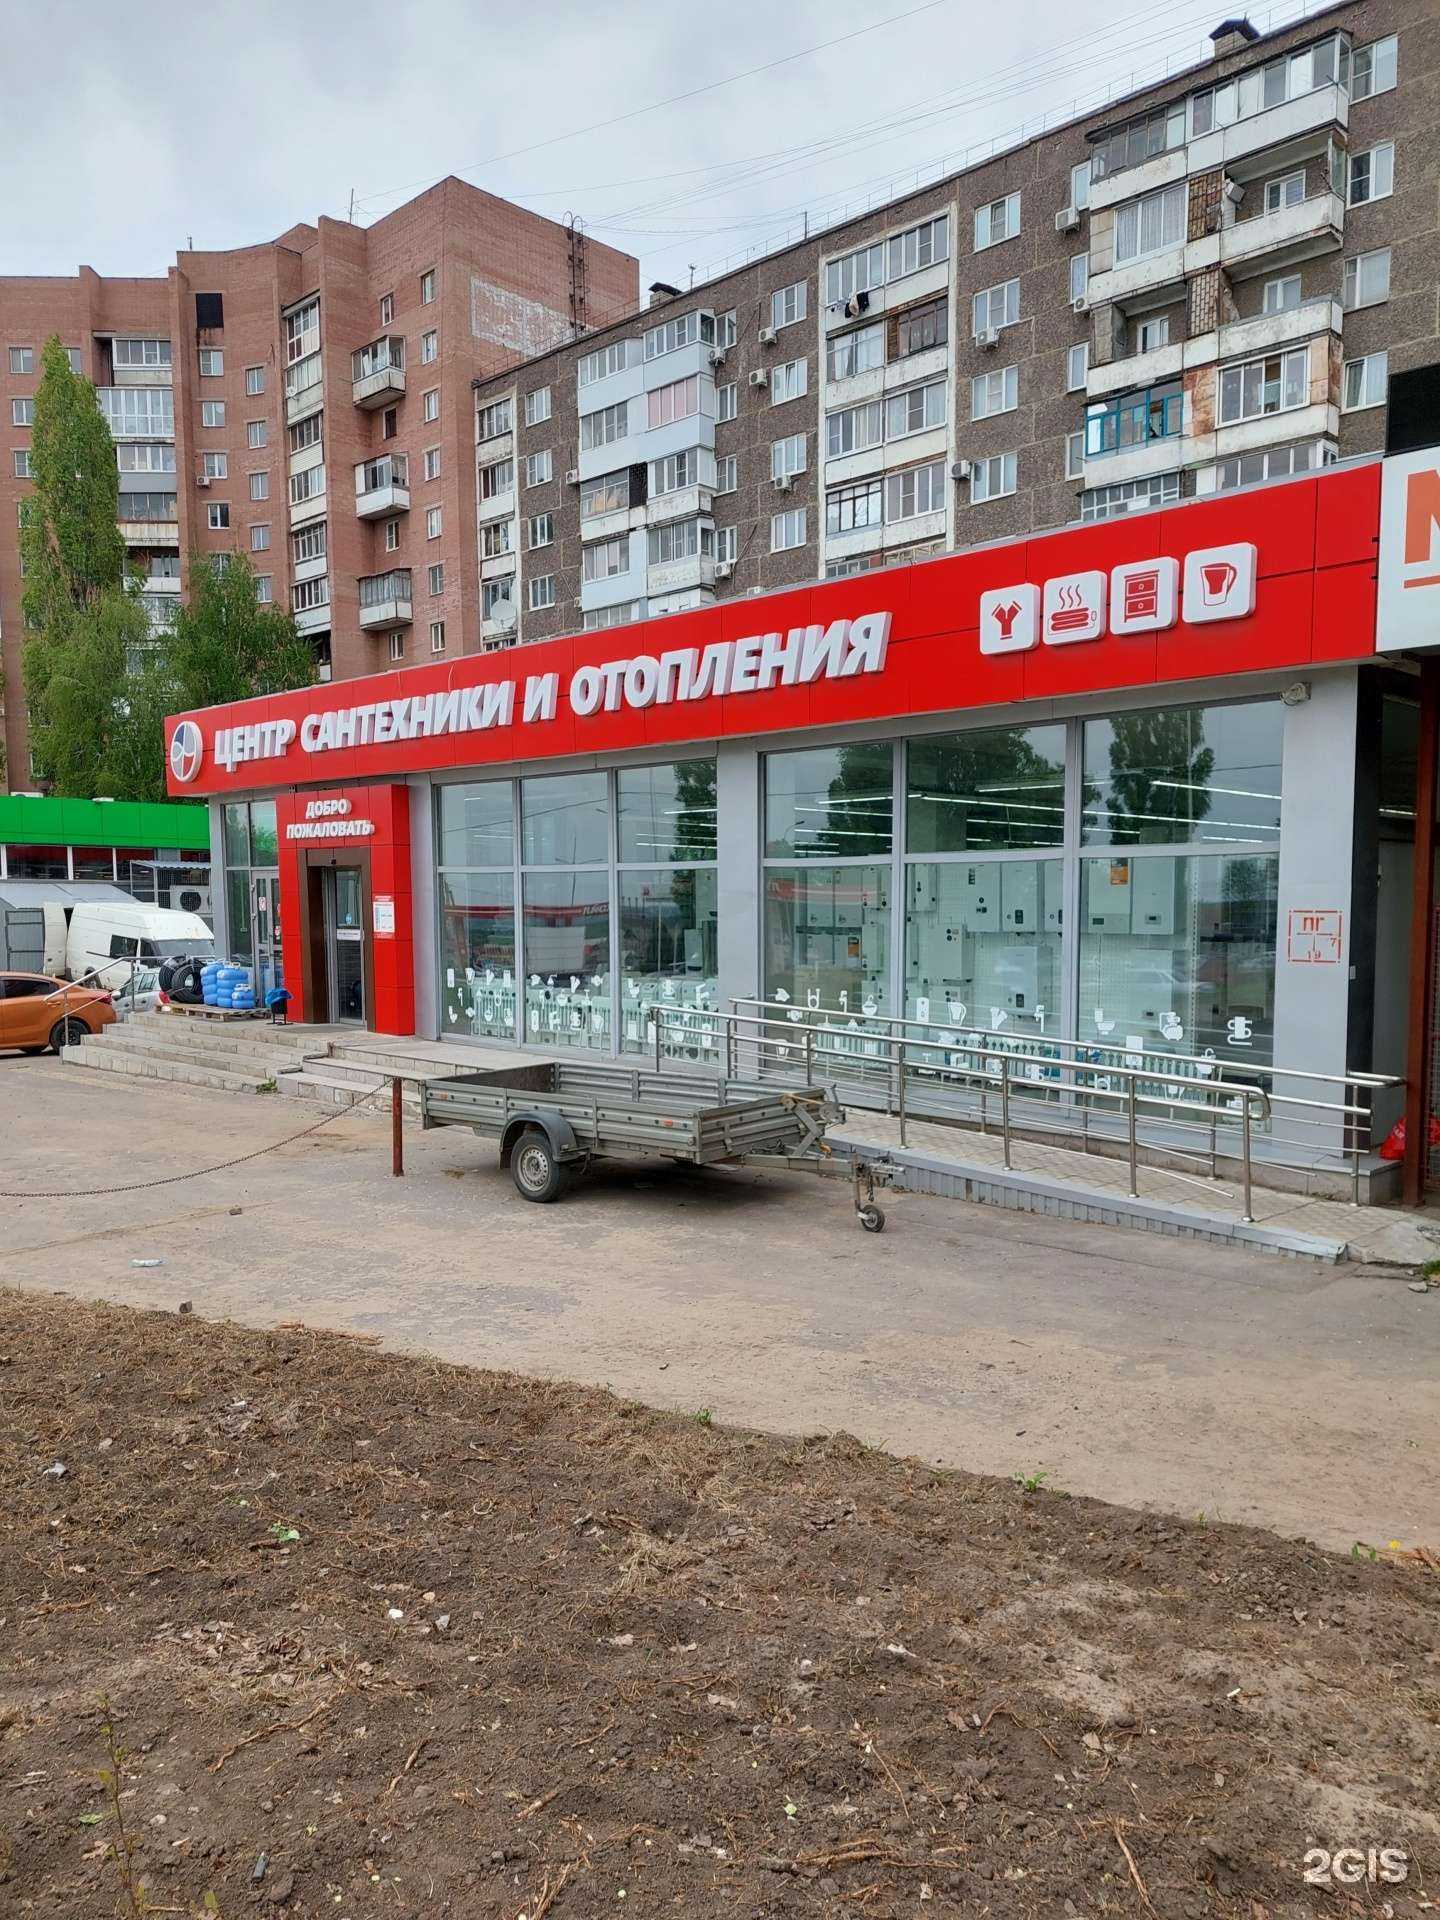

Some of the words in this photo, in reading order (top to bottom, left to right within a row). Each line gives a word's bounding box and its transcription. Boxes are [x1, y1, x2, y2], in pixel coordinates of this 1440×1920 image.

[214, 719, 296, 773] ЦЕНТР
[301, 680, 516, 753] САНТЕХНИКИ
[523, 672, 560, 722] И
[570, 611, 892, 716] ОТОПЛЕНИЯ
[306, 798, 352, 820] ДОБРО
[286, 820, 375, 839] ПОЖАЛОВАТЬ
